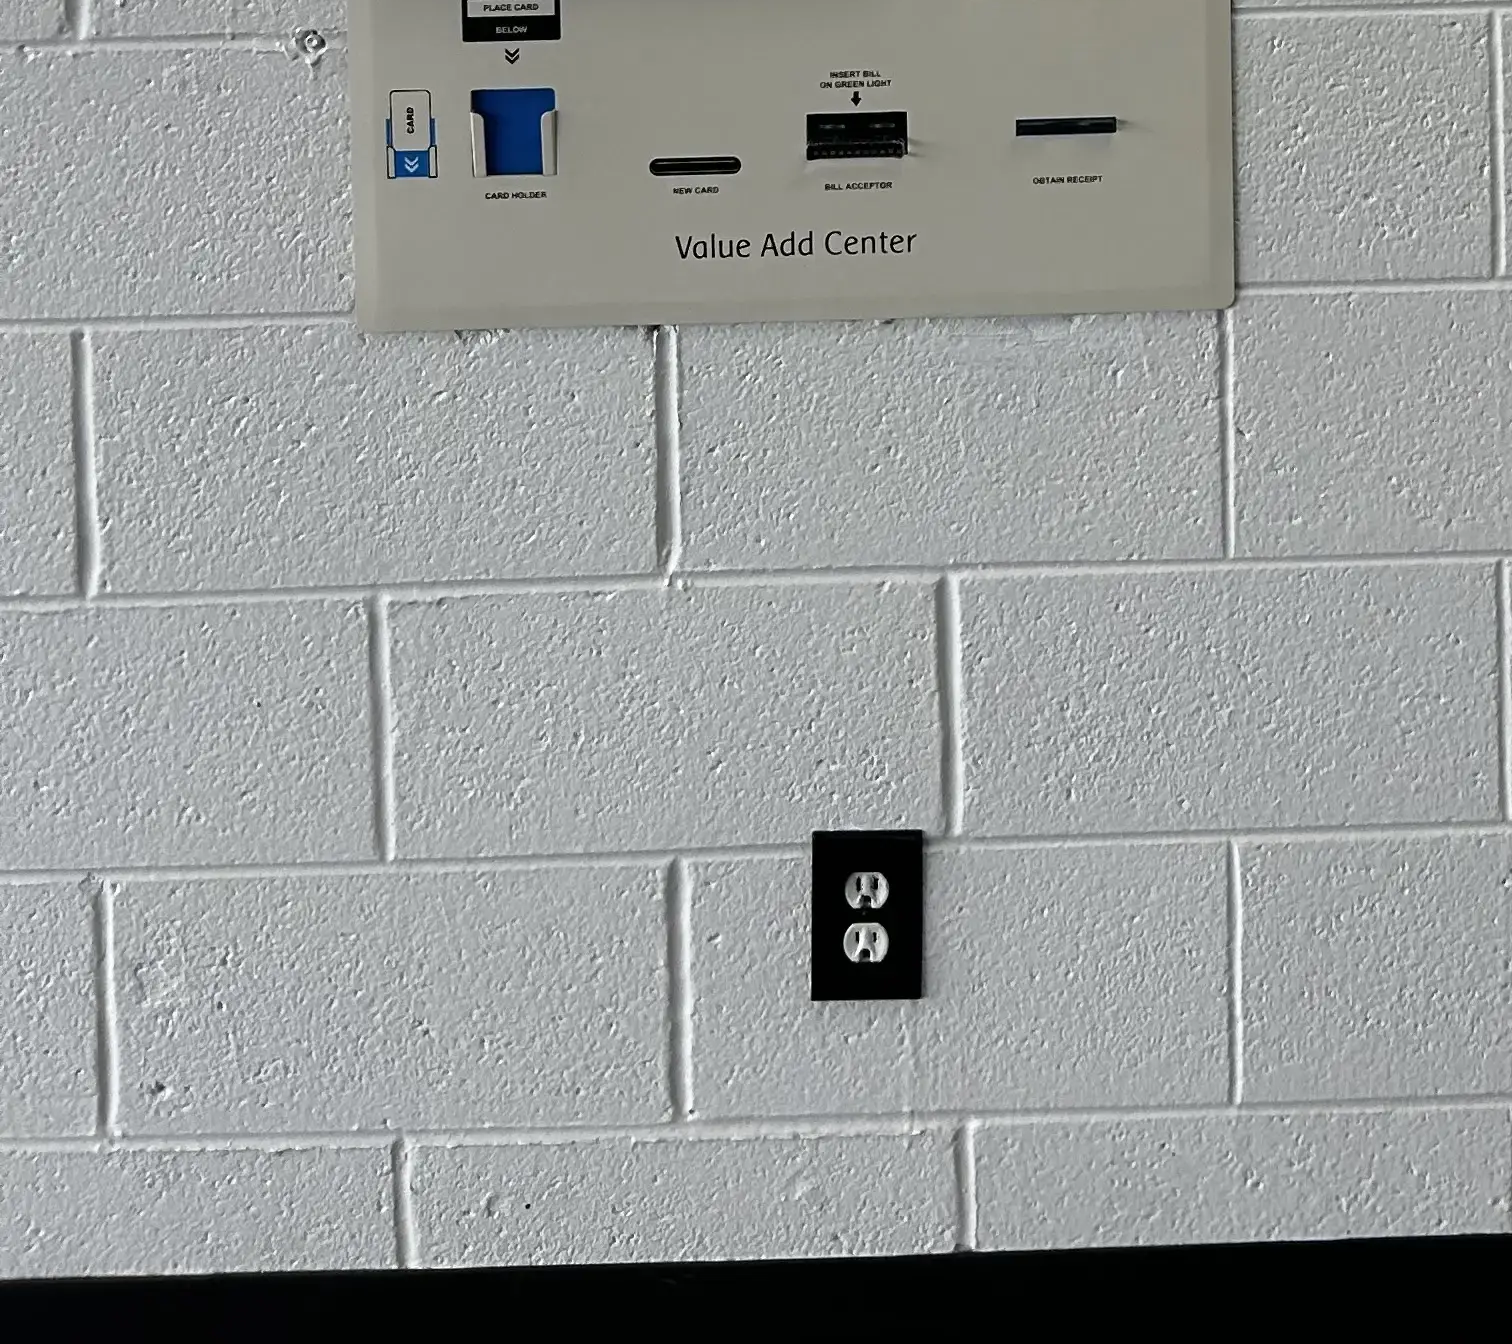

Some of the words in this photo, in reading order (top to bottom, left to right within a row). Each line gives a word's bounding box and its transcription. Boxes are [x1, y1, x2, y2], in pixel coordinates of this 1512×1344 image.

[483, 4, 512, 12] PLACE
[514, 3, 539, 11] CARD
[495, 25, 527, 34] BELOW
[830, 70, 860, 79] INSERT
[863, 70, 881, 78] BILL
[820, 80, 832, 89] ON
[834, 80, 864, 88] GREEN
[866, 79, 891, 87] LIGHT
[406, 107, 415, 134] CARD
[1032, 176, 1065, 184] OBTAIN
[1066, 175, 1102, 184] RECEIPT
[673, 187, 692, 195] NEW
[694, 186, 719, 194] CARD
[824, 183, 843, 191] BILL
[845, 181, 892, 190] ACCEPTOR
[485, 192, 509, 200] CARD
[511, 190, 547, 199] HOLDER
[675, 233, 750, 259] Value
[760, 231, 814, 257] Add
[824, 231, 918, 256] Center
